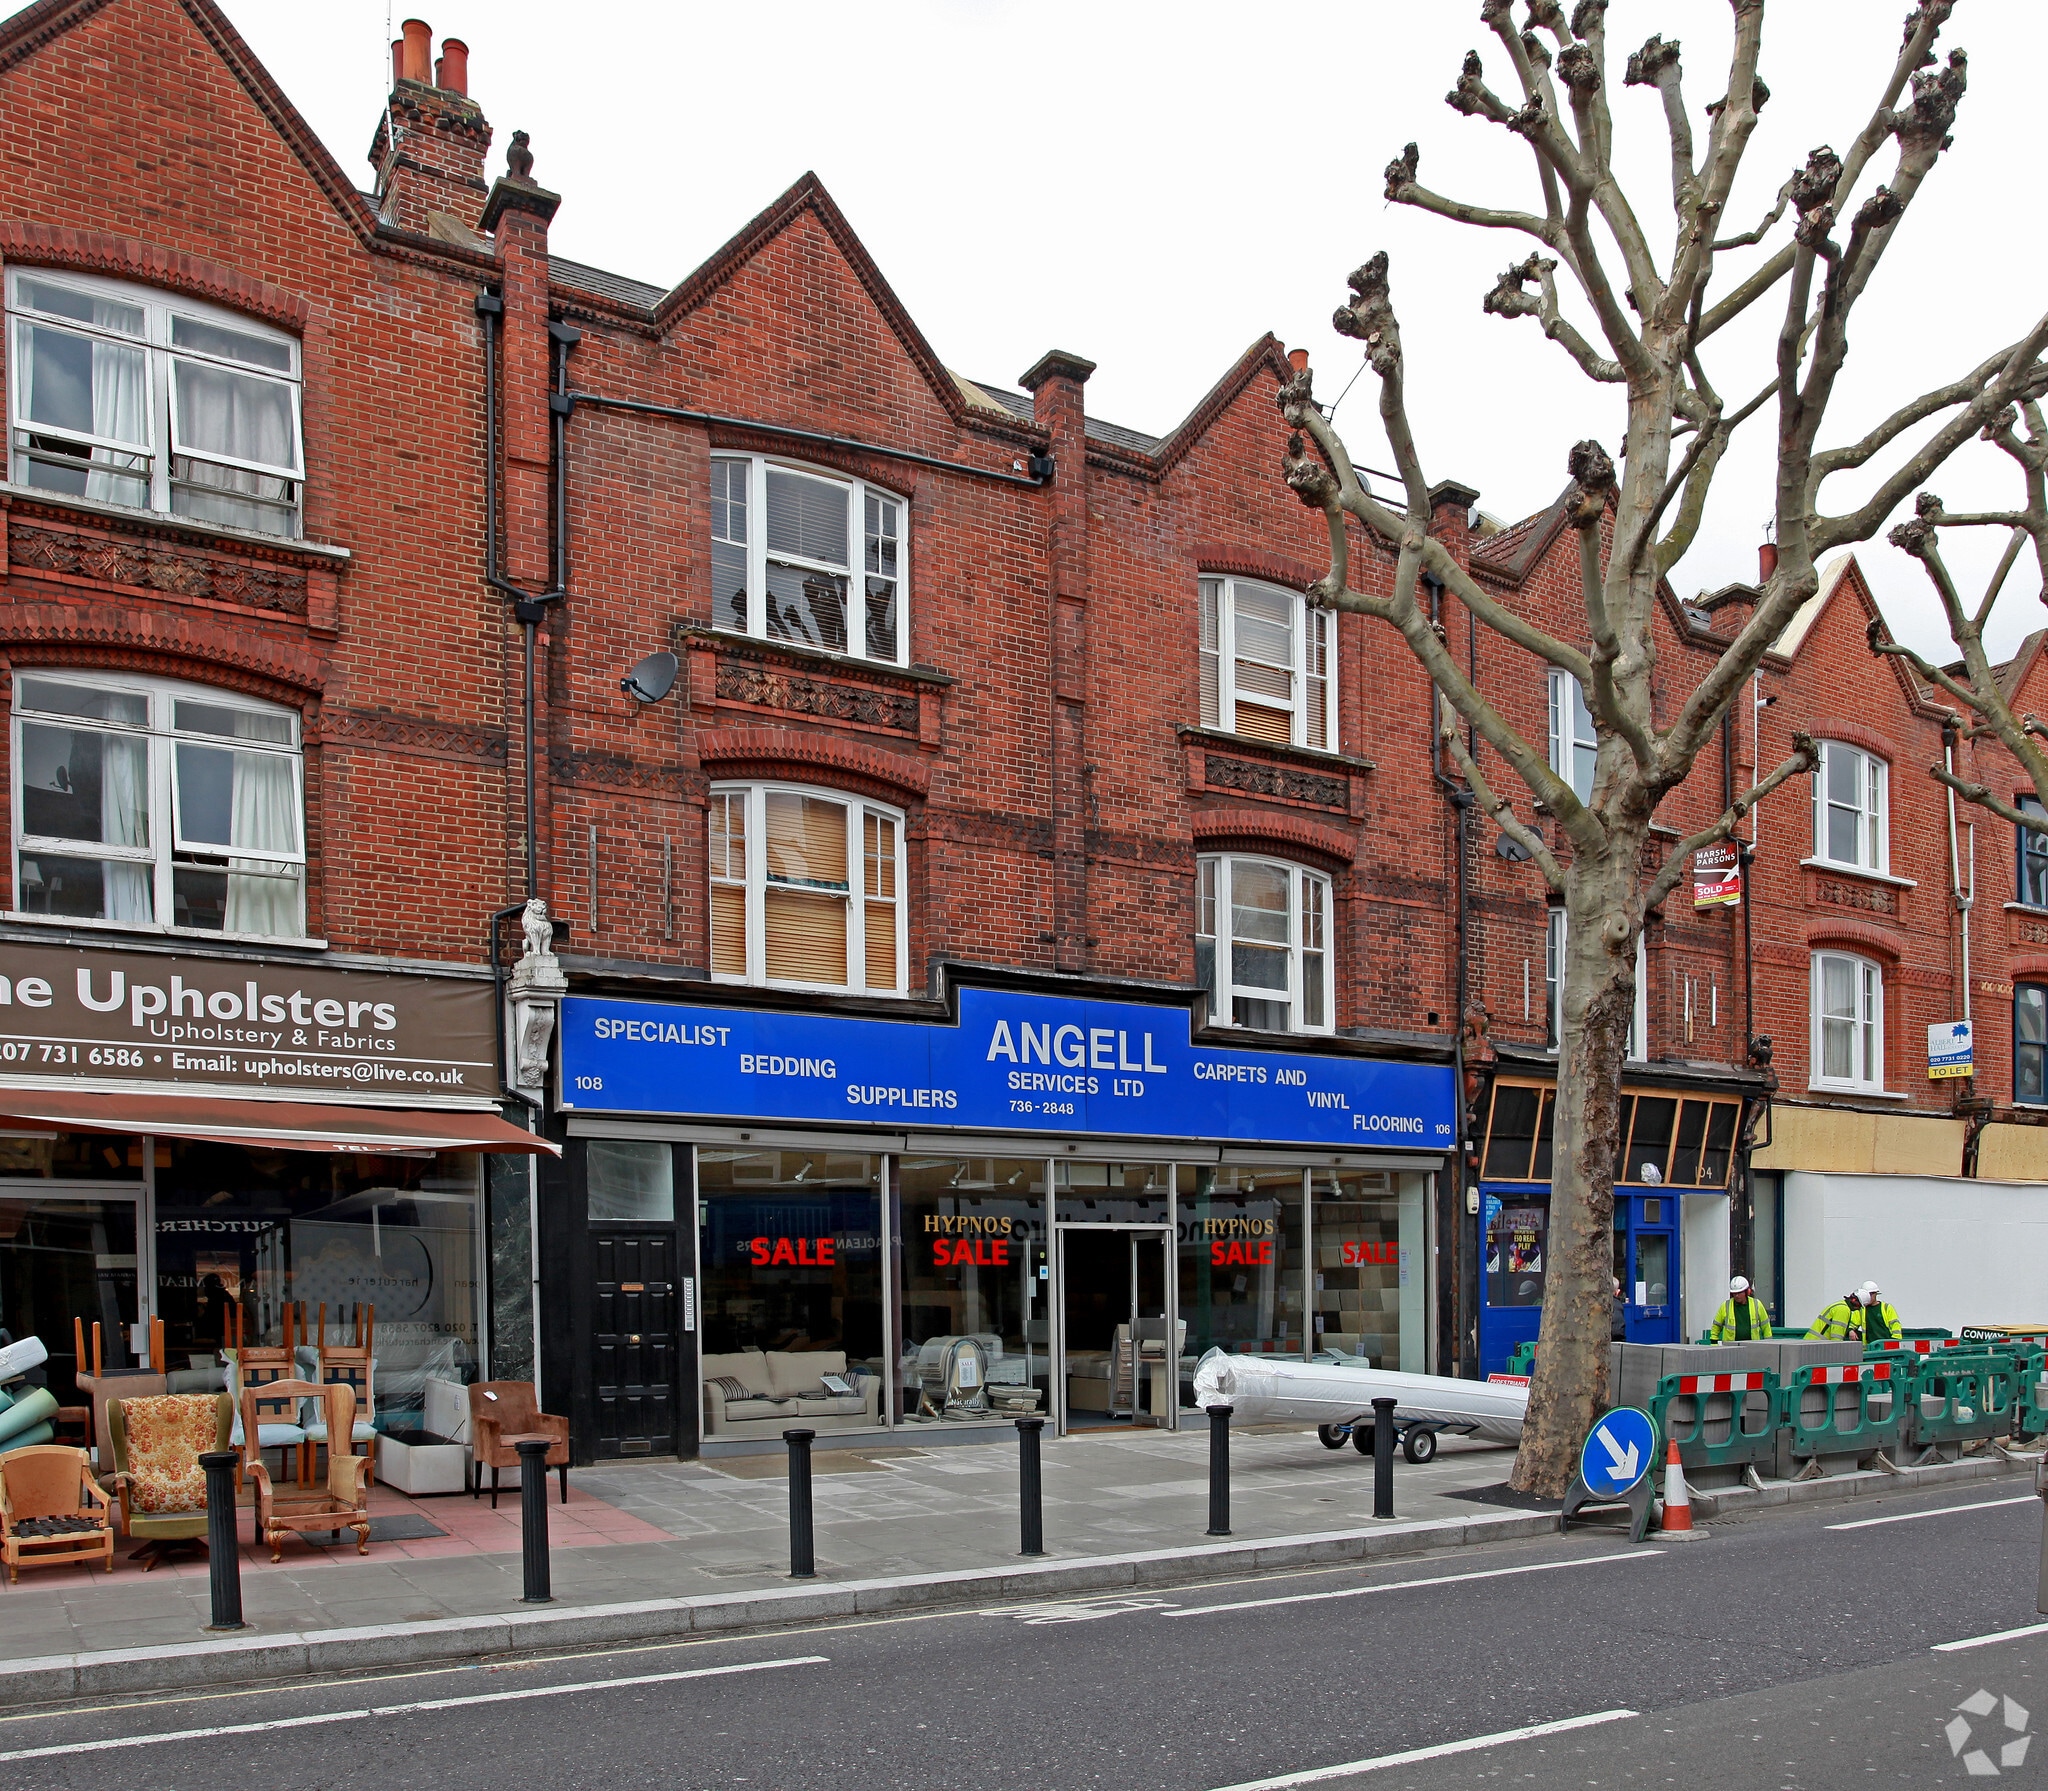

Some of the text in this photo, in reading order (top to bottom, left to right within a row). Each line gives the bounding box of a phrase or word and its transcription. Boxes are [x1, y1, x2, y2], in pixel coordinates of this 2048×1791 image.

[1696, 848, 1726, 860] MARSH
[1696, 853, 1736, 866] PARSONS
[1698, 885, 1723, 896] SOLD
[77, 967, 398, 1031] Upholsters
[150, 1019, 396, 1051] Upholstery & Fabrics
[595, 1018, 730, 1046] SPECIALIST
[987, 1020, 1167, 1074] ANGELL
[39, 1045, 78, 1064] 731
[88, 1047, 144, 1067] 6586
[172, 1052, 238, 1073] Email:
[245, 1058, 464, 1085] upholsters@live.co.uk
[741, 1054, 836, 1079] BEDDING
[1194, 1062, 1307, 1086] CARPETS AND
[1933, 1066, 1968, 1076] TO LET
[575, 1076, 602, 1090] 108
[1007, 1071, 1145, 1097] SERVICES LTD
[847, 1084, 957, 1108] SUPPLIERS
[1307, 1091, 1350, 1110] VINYL
[1353, 1114, 1424, 1134] FLOORING
[1435, 1123, 1451, 1135] 106
[925, 1215, 1012, 1233] HYPNOS
[1205, 1218, 1274, 1235] HYPNOS
[1523, 1235, 1536, 1243] REAL
[751, 1237, 835, 1266] SALE
[933, 1239, 1009, 1265] SALE
[1211, 1241, 1272, 1265] SALE
[1343, 1241, 1398, 1264] SALE
